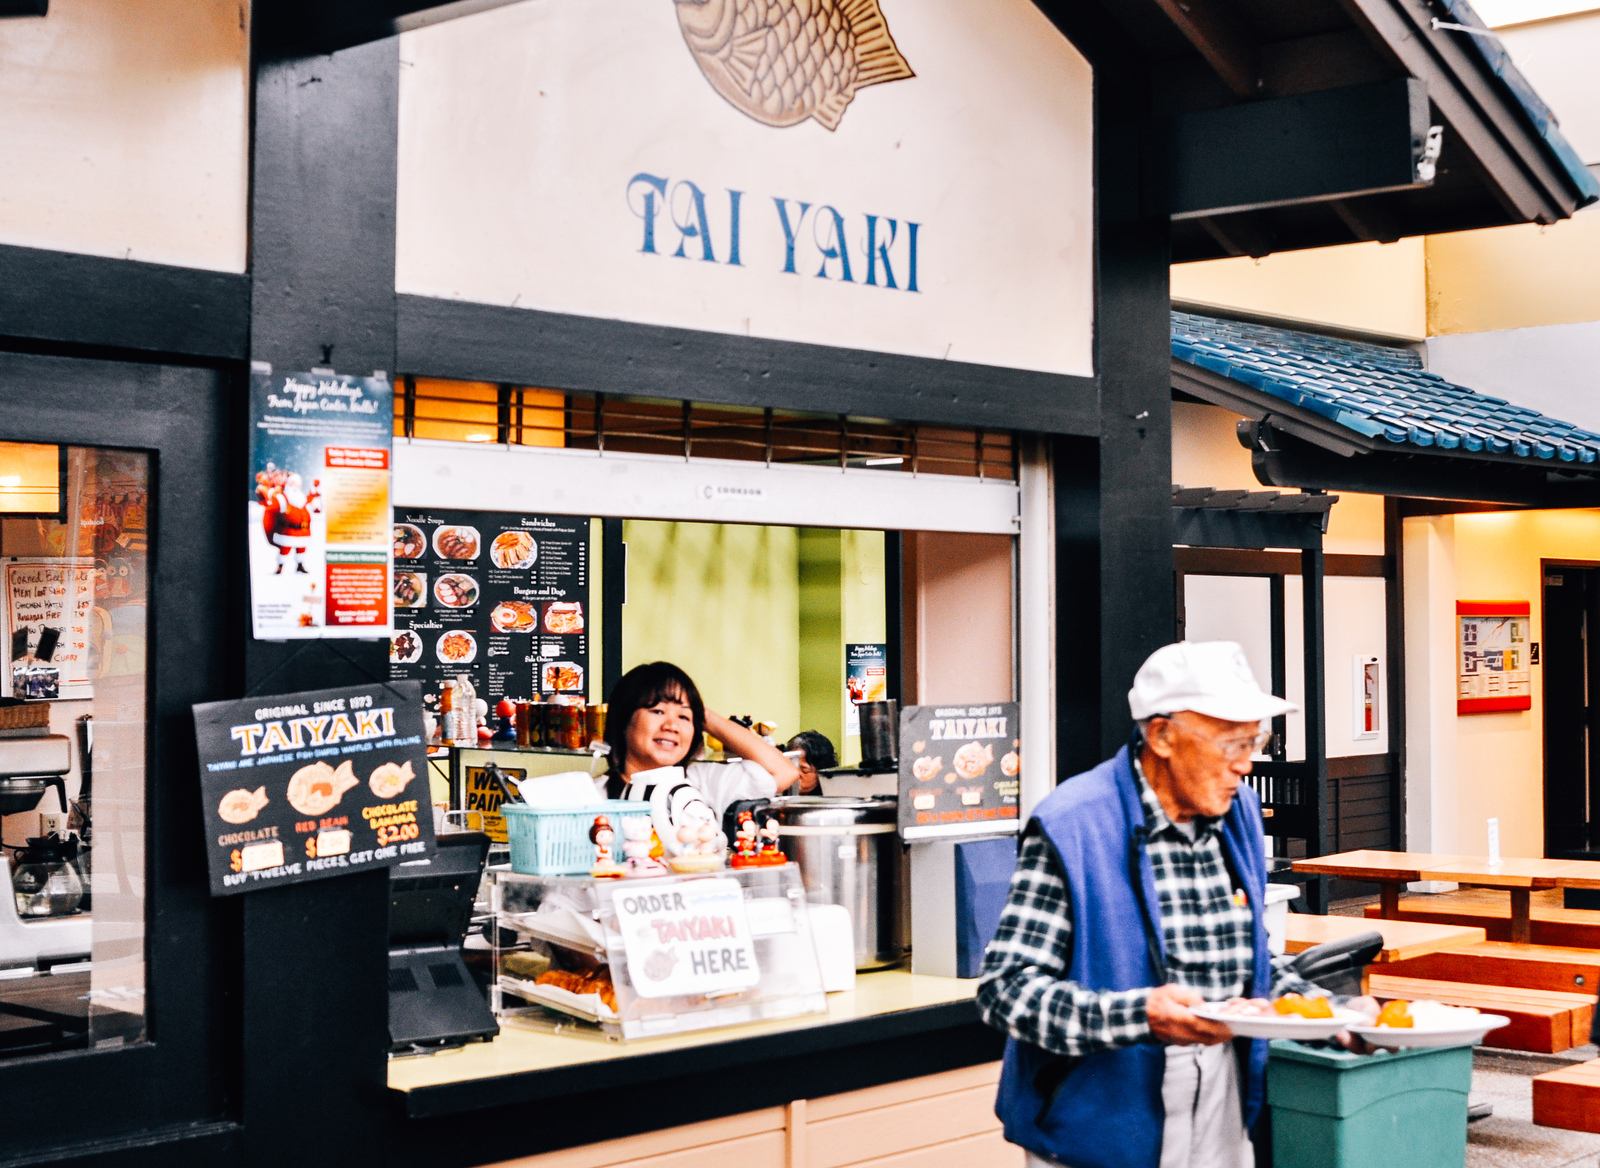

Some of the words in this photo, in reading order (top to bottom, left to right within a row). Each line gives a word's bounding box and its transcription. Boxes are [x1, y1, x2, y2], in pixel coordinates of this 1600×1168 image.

[626, 172, 746, 267] TAI
[770, 196, 922, 294] YAKI
[406, 515, 426, 524] Noodle
[427, 515, 444, 525] Soups
[521, 517, 556, 527] Sandwiches
[513, 586, 538, 596] Burgers
[538, 586, 550, 595] and
[551, 587, 566, 596] Dogs
[409, 619, 443, 630] Specialties
[255, 703, 309, 721] ORIGINAL
[313, 698, 345, 714] SINCE
[230, 707, 396, 756] TAIYAKI
[929, 717, 1008, 740] TAIYAKI
[362, 800, 418, 820] CHOCOLATE
[369, 812, 416, 830] BANANA
[218, 826, 280, 846] CHOCOLATE
[295, 819, 317, 833] RED
[376, 823, 419, 847] $2.00
[223, 872, 248, 887] BUY
[252, 862, 302, 881] TWELVE
[349, 849, 373, 864] GET
[374, 845, 398, 860] ONE
[401, 841, 425, 854] FREE
[623, 892, 687, 915] ORDER
[651, 915, 736, 944] TAIYAKI
[690, 948, 750, 976] HERE
